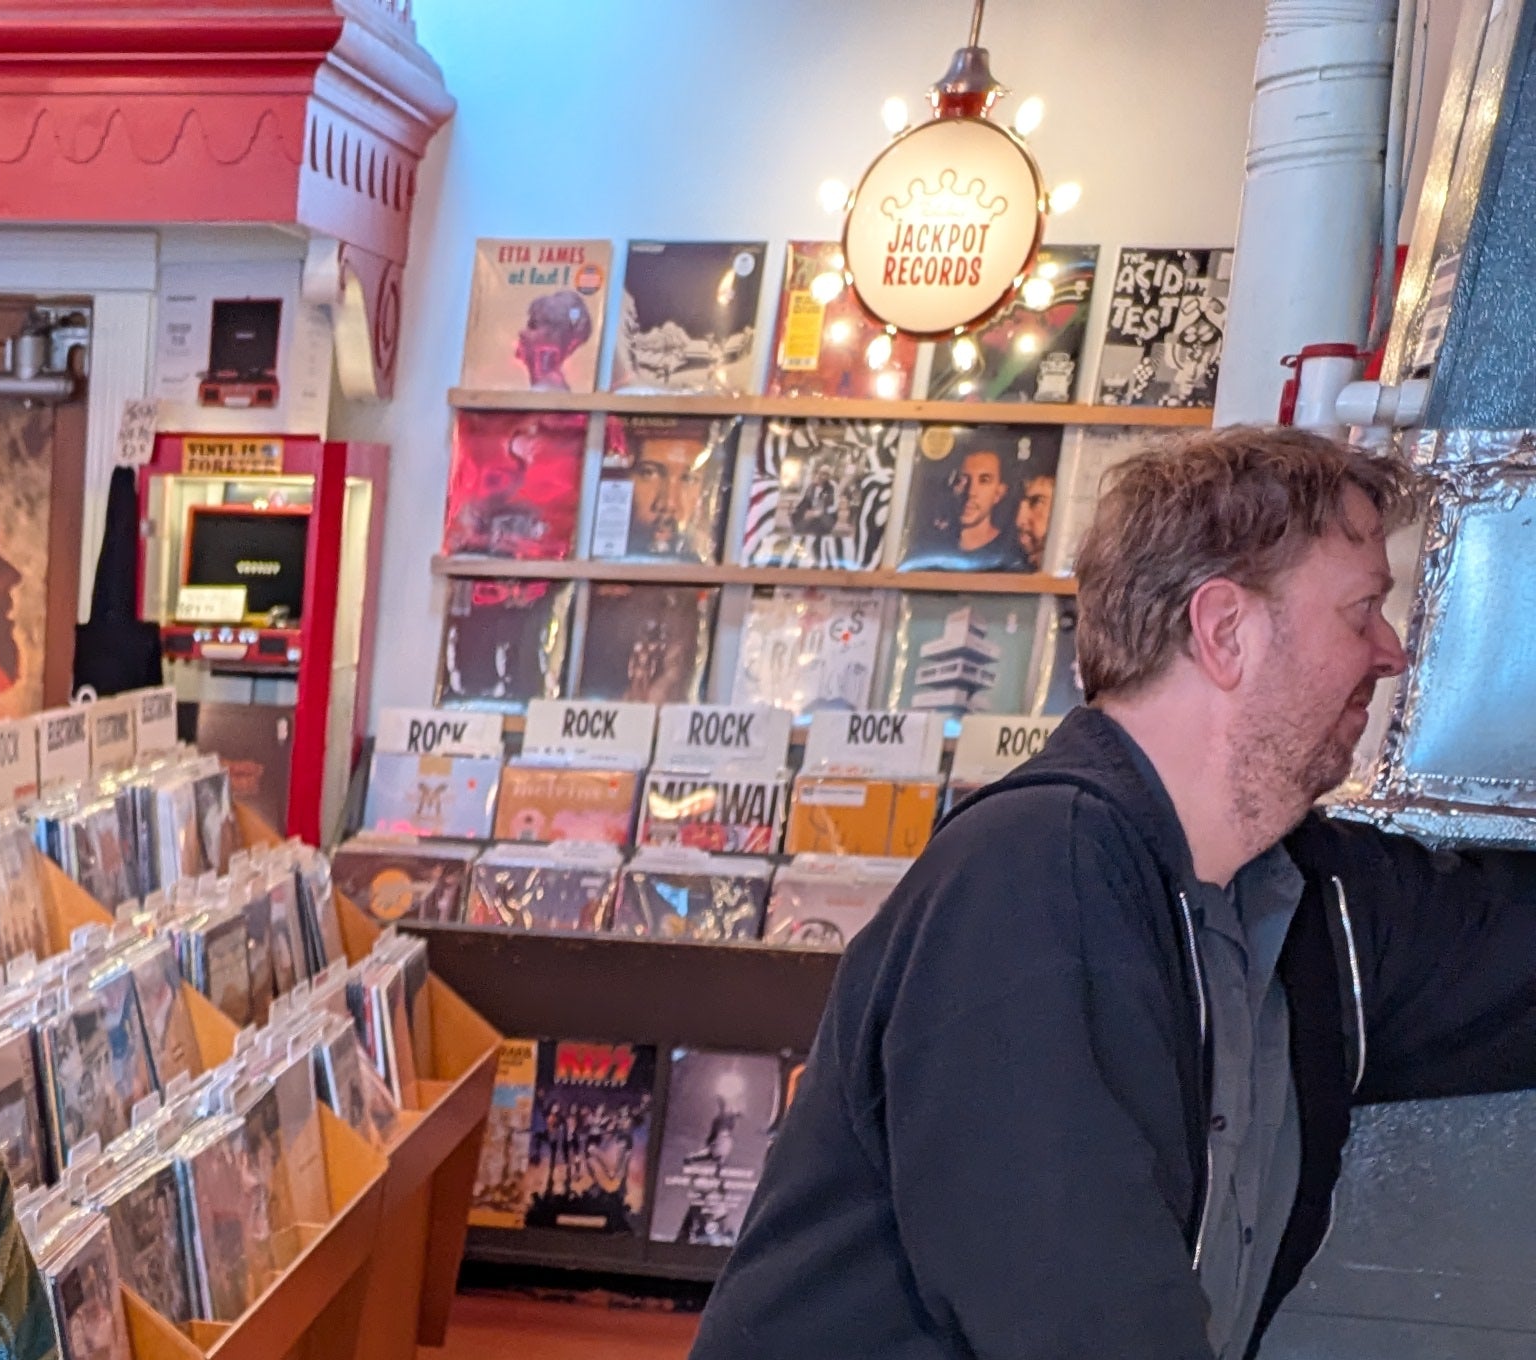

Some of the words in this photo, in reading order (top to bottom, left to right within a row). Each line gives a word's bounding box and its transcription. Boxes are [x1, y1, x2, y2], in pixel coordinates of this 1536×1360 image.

[887, 220, 991, 254] JACKPOT
[498, 247, 531, 264] ETTA
[537, 247, 585, 264] JAMES
[882, 256, 983, 287] RECORDS
[1123, 252, 1148, 265] THE
[1116, 259, 1184, 296] ACID
[1111, 296, 1181, 340] TEST
[187, 442, 234, 457] VINYL
[562, 709, 616, 740] ROCK
[687, 712, 755, 748] ROCK
[846, 713, 906, 745] ROCK
[554, 1043, 637, 1080] KISS
